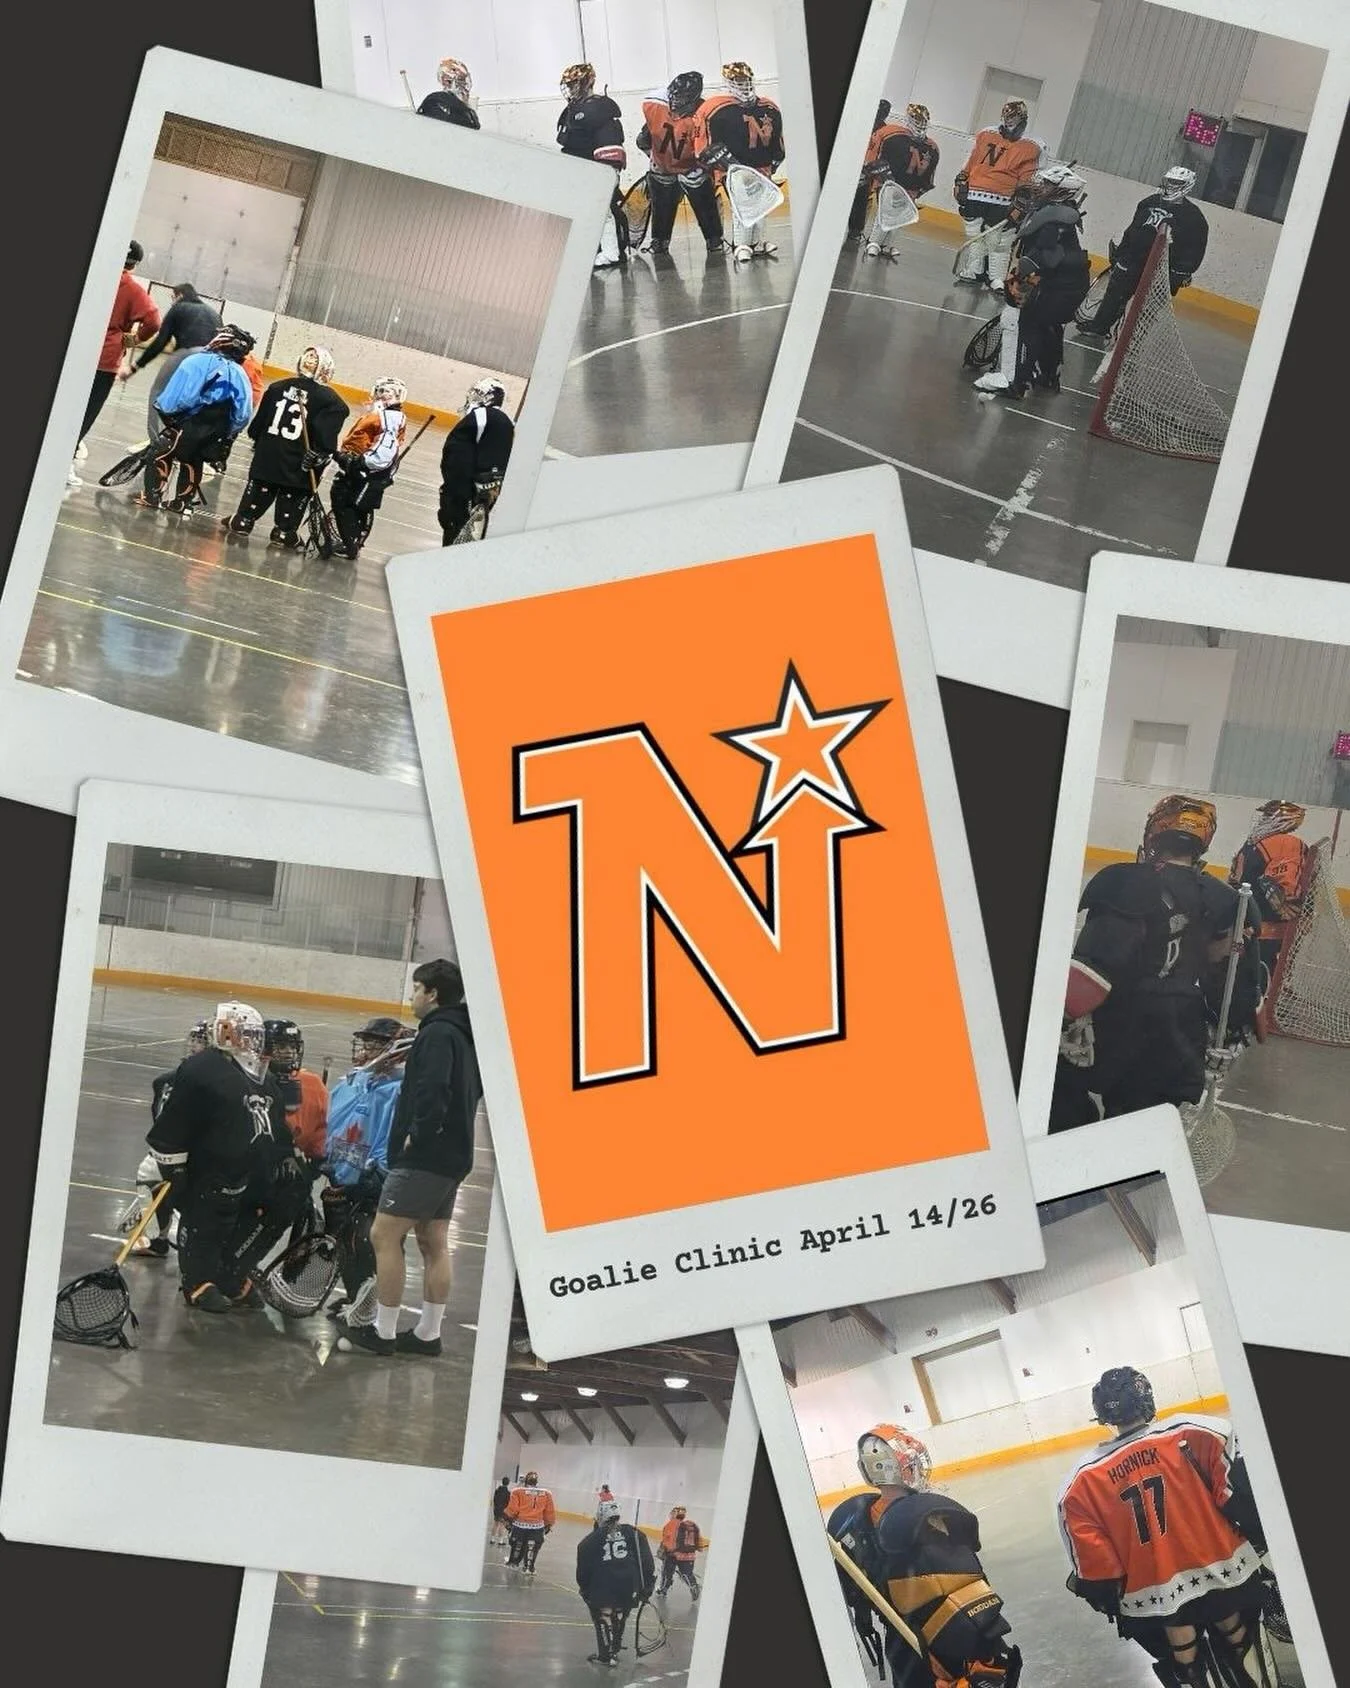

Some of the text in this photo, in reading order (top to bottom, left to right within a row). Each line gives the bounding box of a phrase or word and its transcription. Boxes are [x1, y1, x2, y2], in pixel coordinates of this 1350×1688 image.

[660, 121, 688, 160] N
[979, 142, 1008, 167] N
[267, 398, 308, 440] 13
[1107, 1447, 1161, 1485] HORNICK
[1119, 1474, 1167, 1545] 17
[602, 1540, 628, 1560] 16
